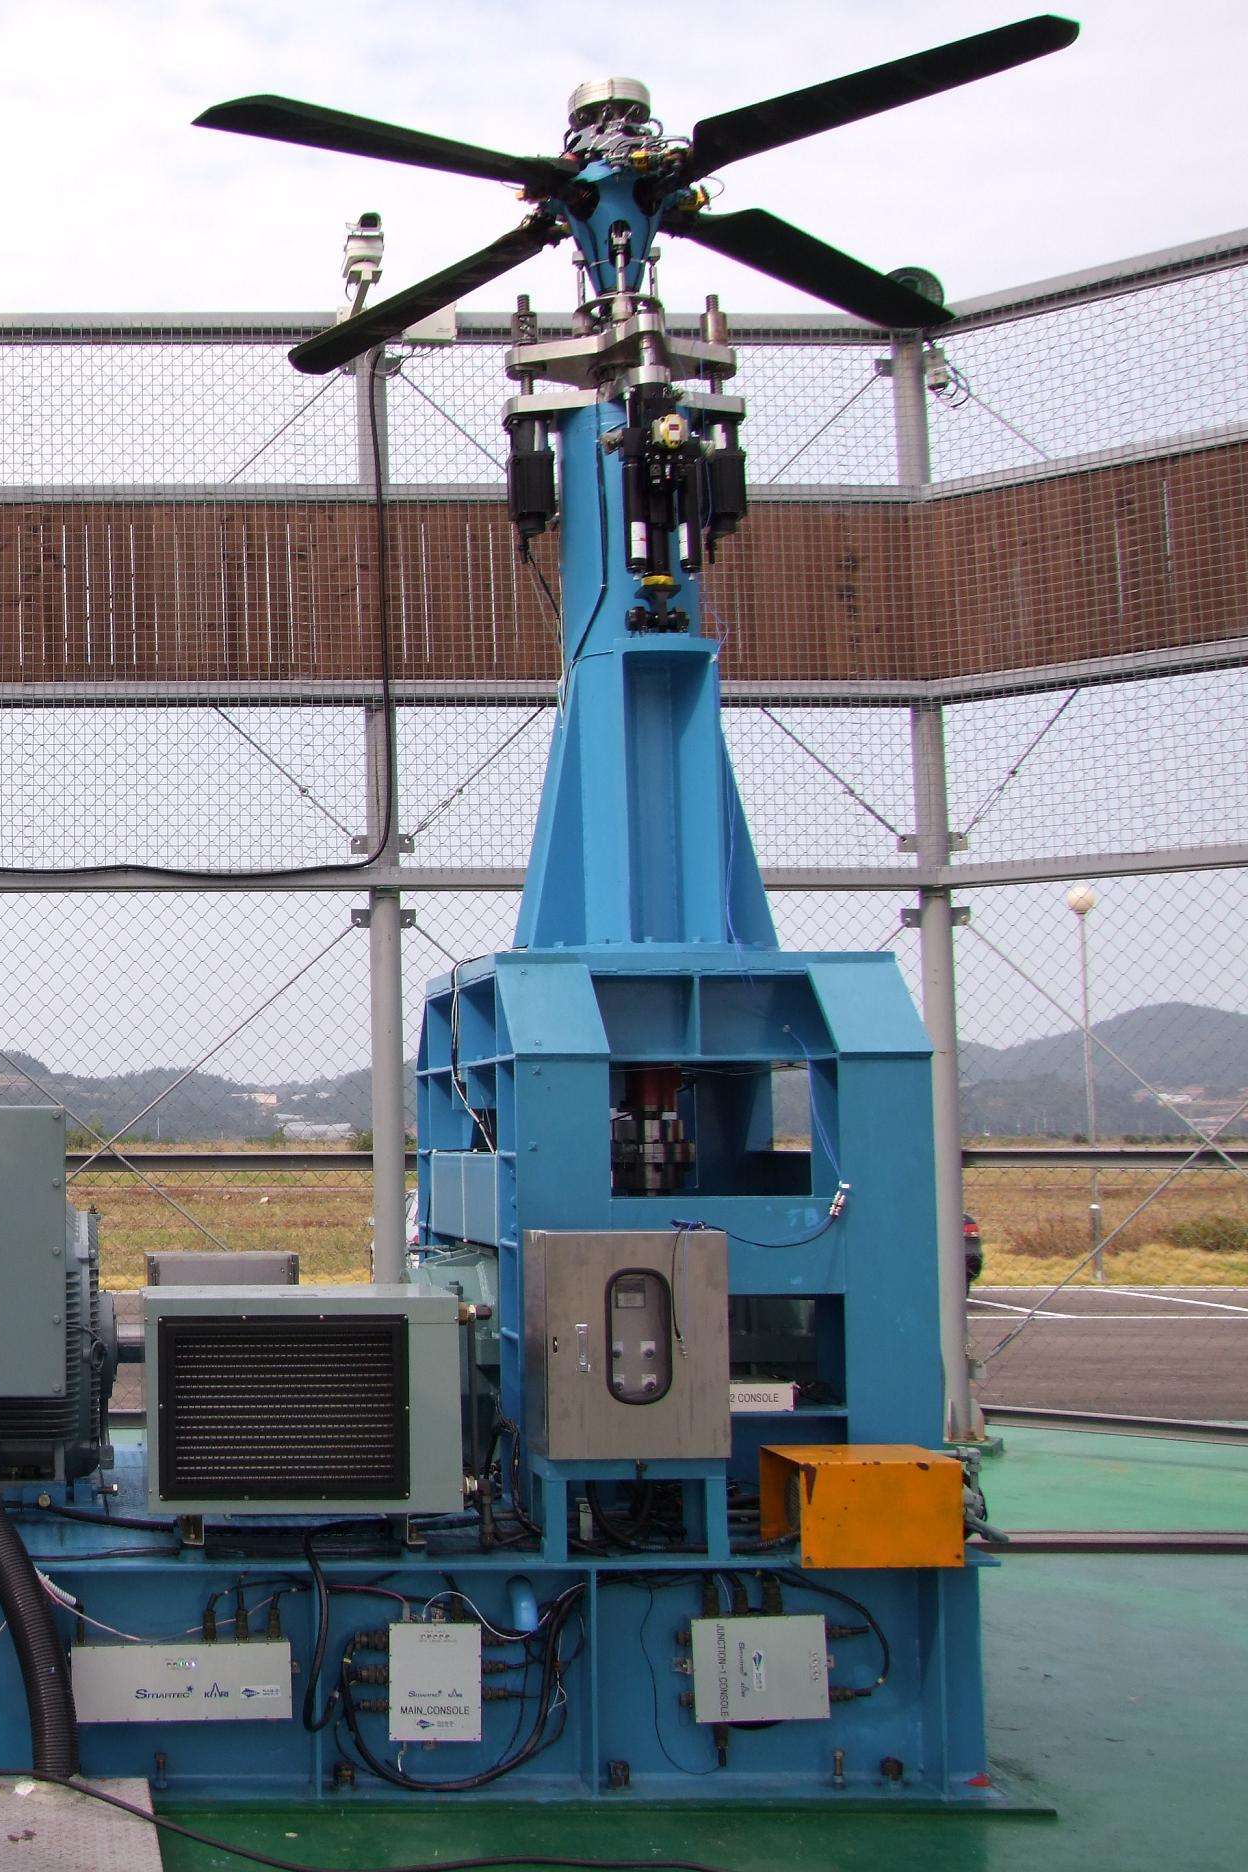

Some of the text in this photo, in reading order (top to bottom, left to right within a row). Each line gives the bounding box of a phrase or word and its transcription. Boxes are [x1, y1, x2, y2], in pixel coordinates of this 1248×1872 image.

[737, 1392, 780, 1403] CONSOLE
[717, 1623, 729, 1717] JUNCTION-1 CONSOLE
[400, 1705, 470, 1716] MAIN_CONSOLE
